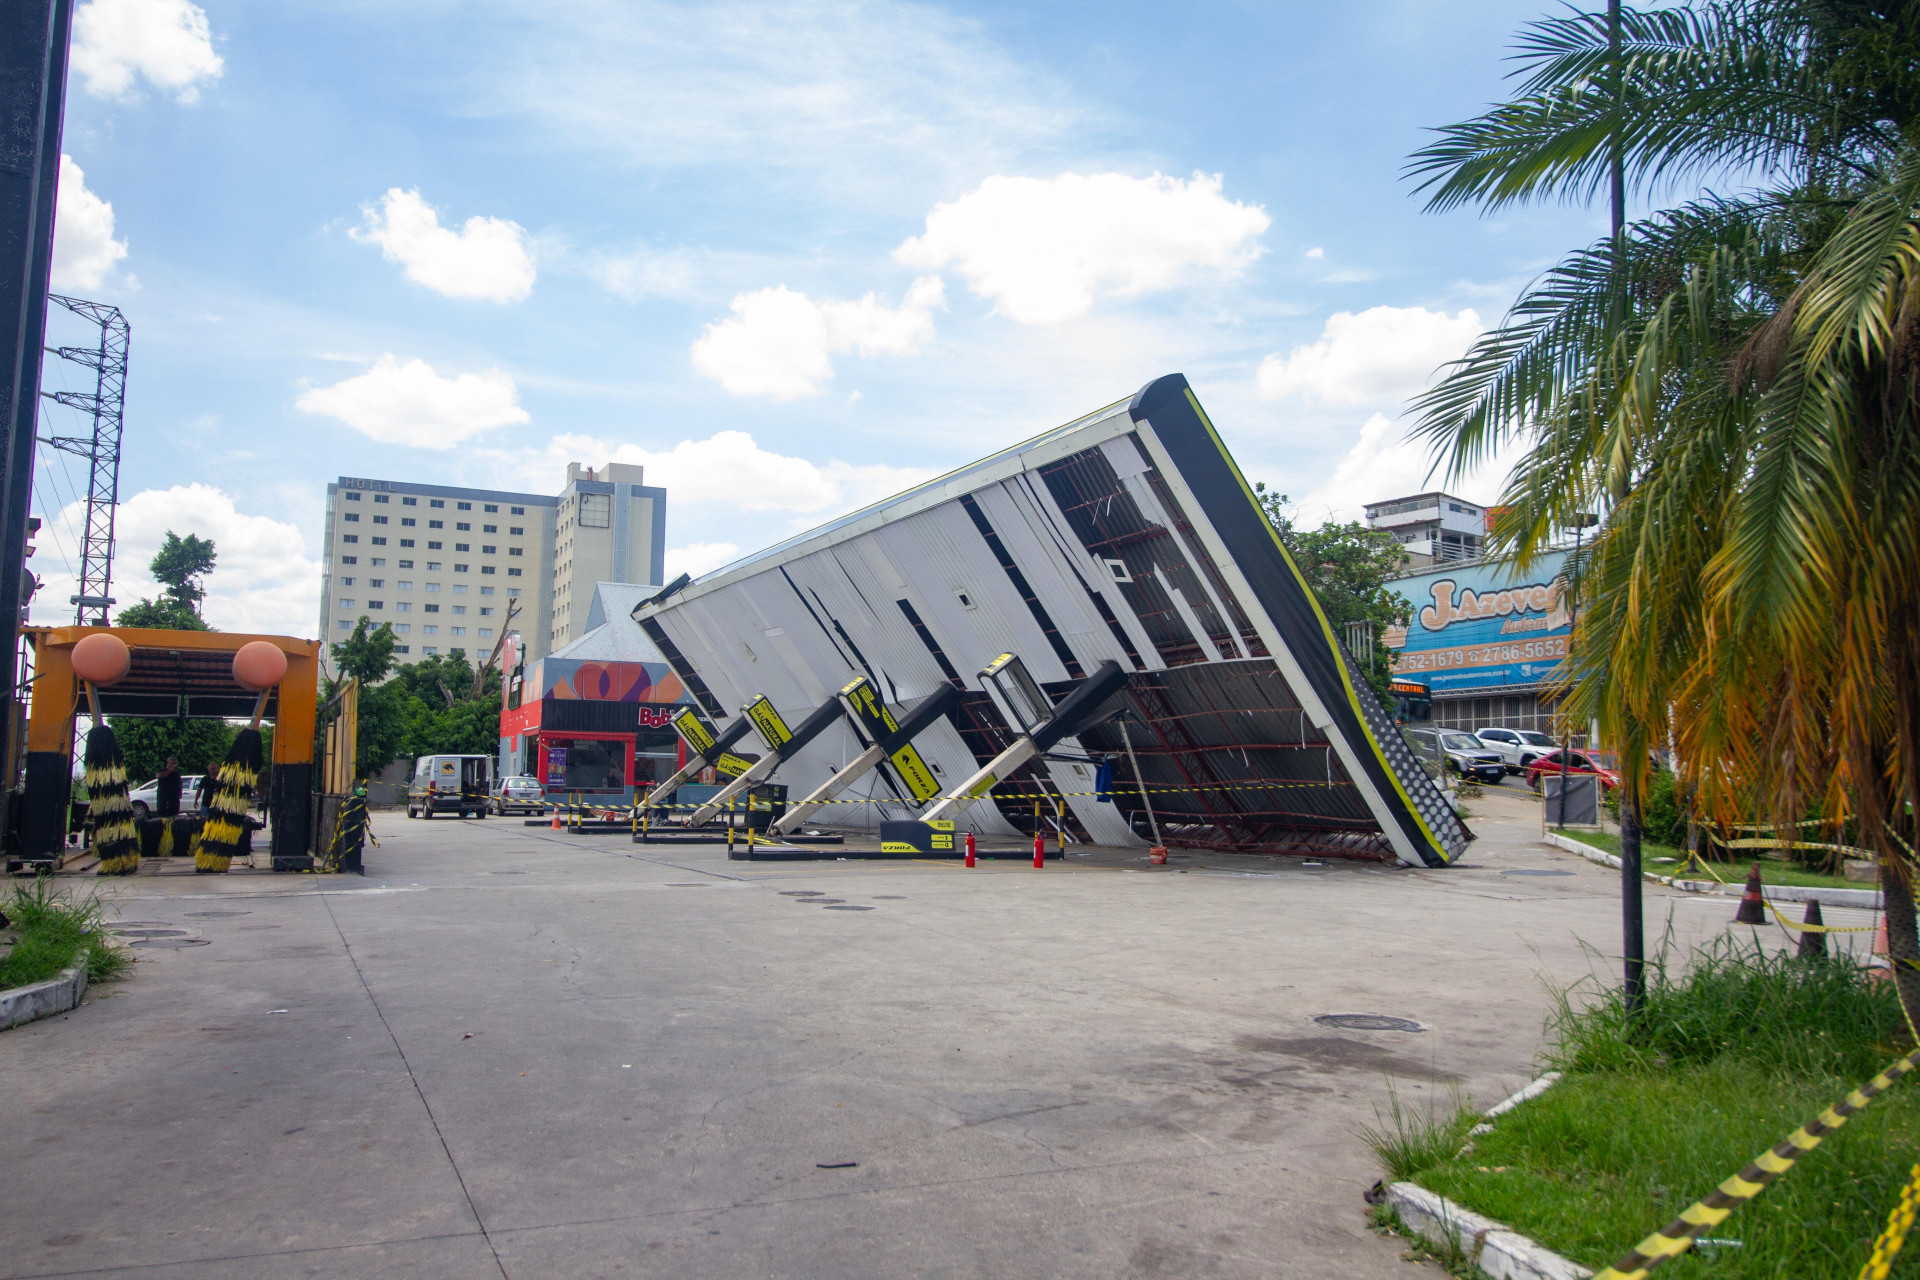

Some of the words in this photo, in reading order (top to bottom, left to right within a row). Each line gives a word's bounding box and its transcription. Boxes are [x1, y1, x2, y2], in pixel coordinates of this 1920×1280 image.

[345, 477, 396, 493] HOTEL
[1420, 575, 1568, 632] J.Azeve
[1393, 650, 1464, 671] 2752-1679
[1482, 639, 1566, 664] 2786-5652
[638, 707, 675, 728] Bob'
[762, 701, 777, 720] FORZA
[883, 712, 897, 731] FORZA
[687, 728, 706, 751] NATURAL
[762, 719, 782, 746] NATURAL
[723, 754, 741, 763] FORZA
[908, 766, 930, 794] FORZA
